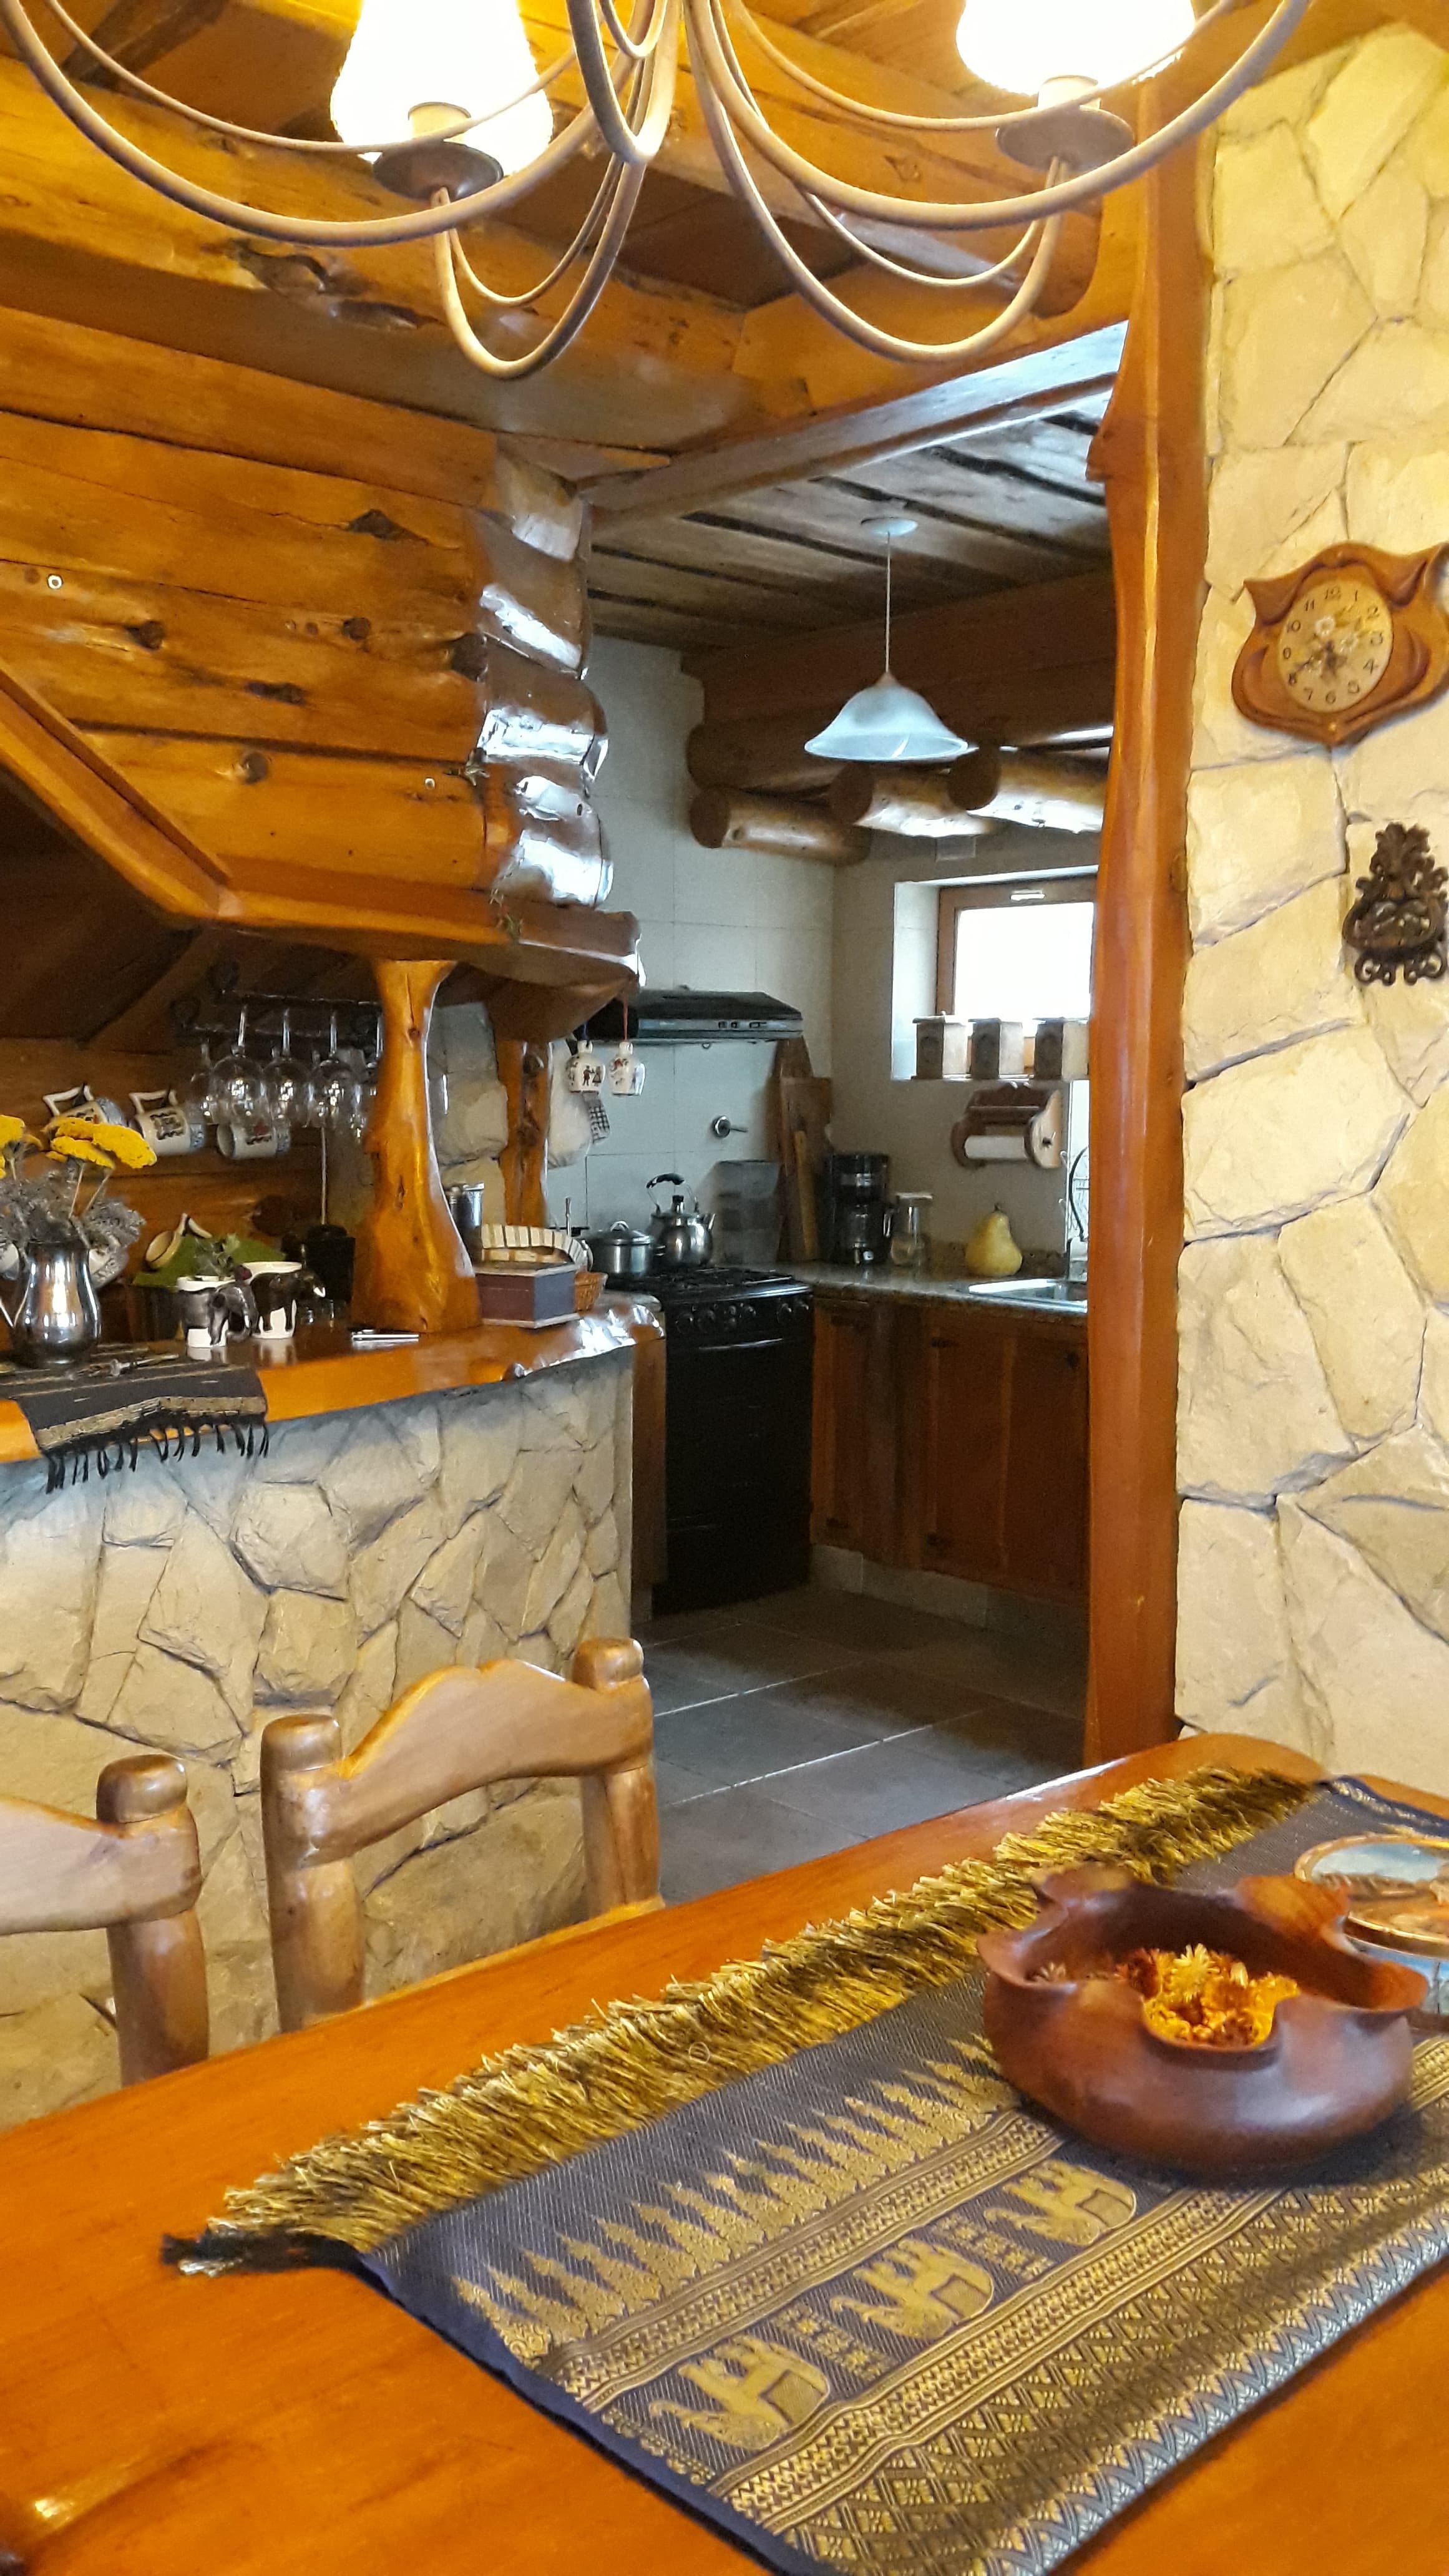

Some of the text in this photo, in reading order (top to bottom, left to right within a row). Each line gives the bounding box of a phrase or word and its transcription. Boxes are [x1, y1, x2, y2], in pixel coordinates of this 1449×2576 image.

[1324, 585, 1342, 600] 12
[1304, 599, 1315, 612] 11
[1367, 607, 1380, 620] 2
[1287, 620, 1301, 633] 10
[1363, 659, 1378, 675] 4
[1303, 687, 1314, 700] 7
